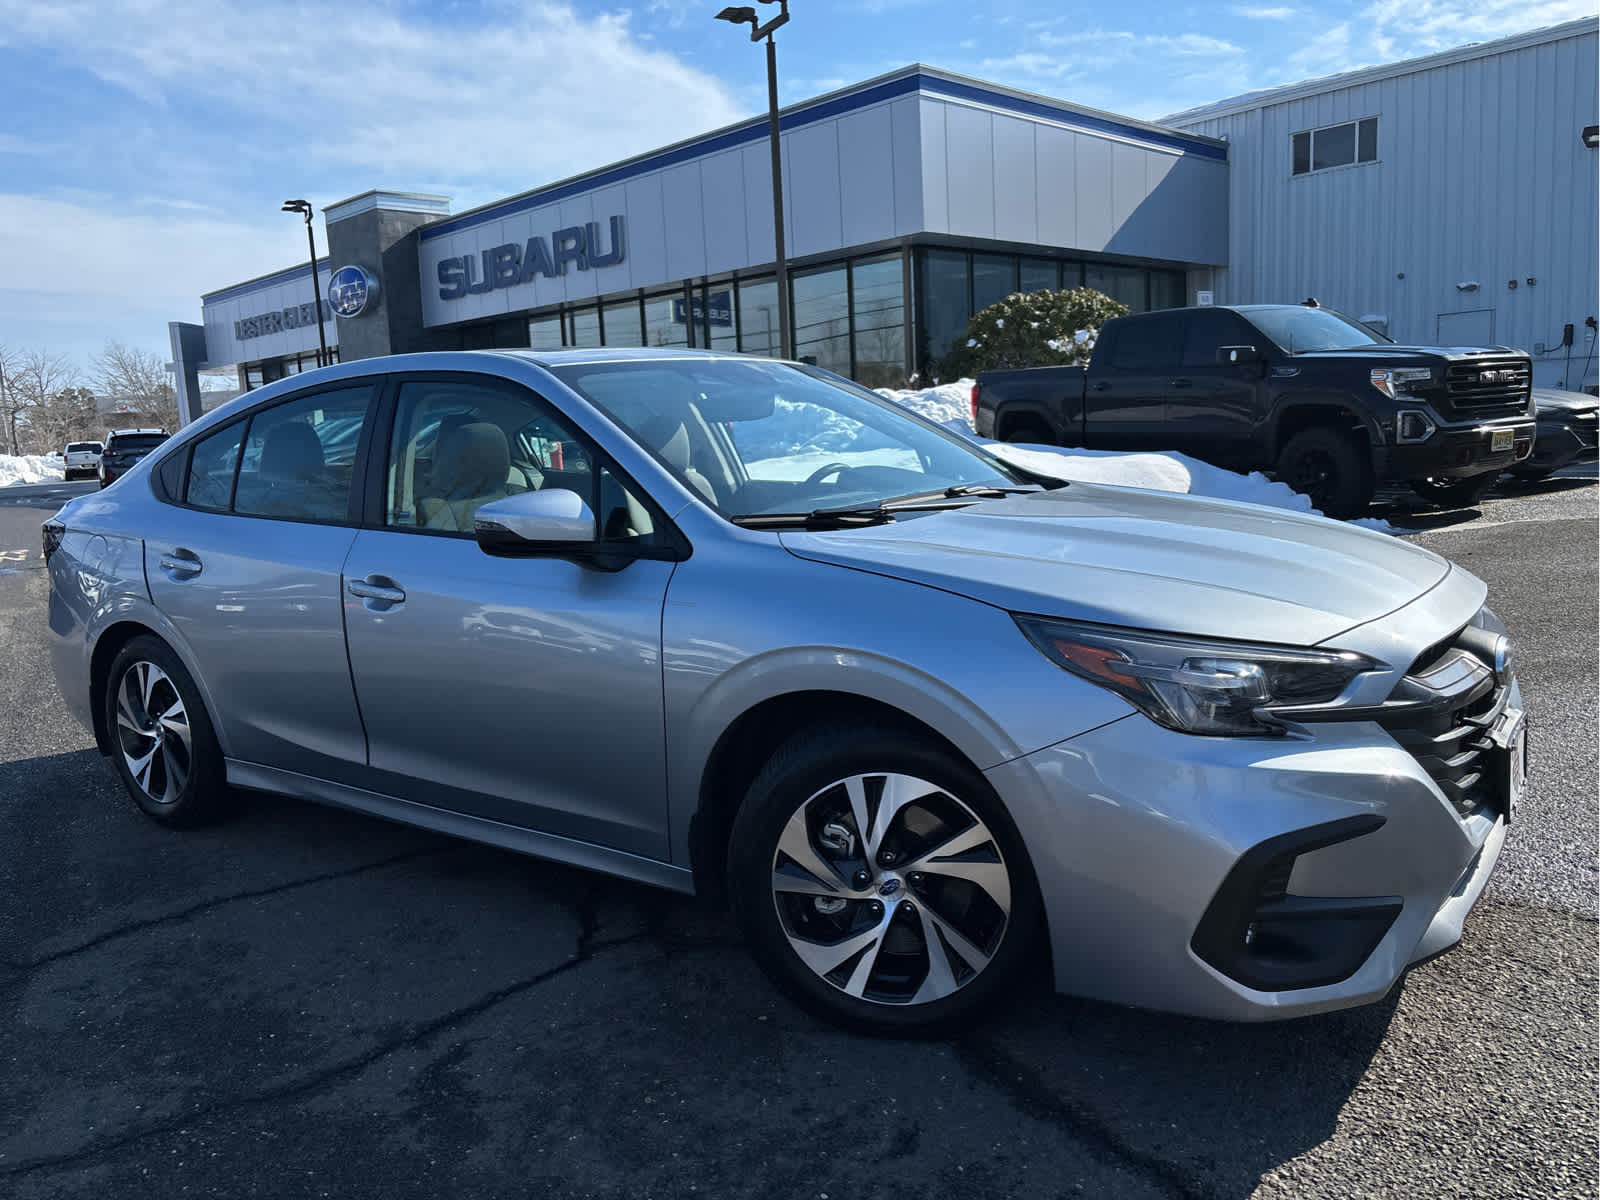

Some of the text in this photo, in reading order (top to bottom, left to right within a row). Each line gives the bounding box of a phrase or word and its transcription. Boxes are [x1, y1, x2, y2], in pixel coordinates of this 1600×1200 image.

[437, 215, 625, 301] SUBARU
[234, 311, 284, 341] LESTER
[1480, 369, 1515, 384] GMC
